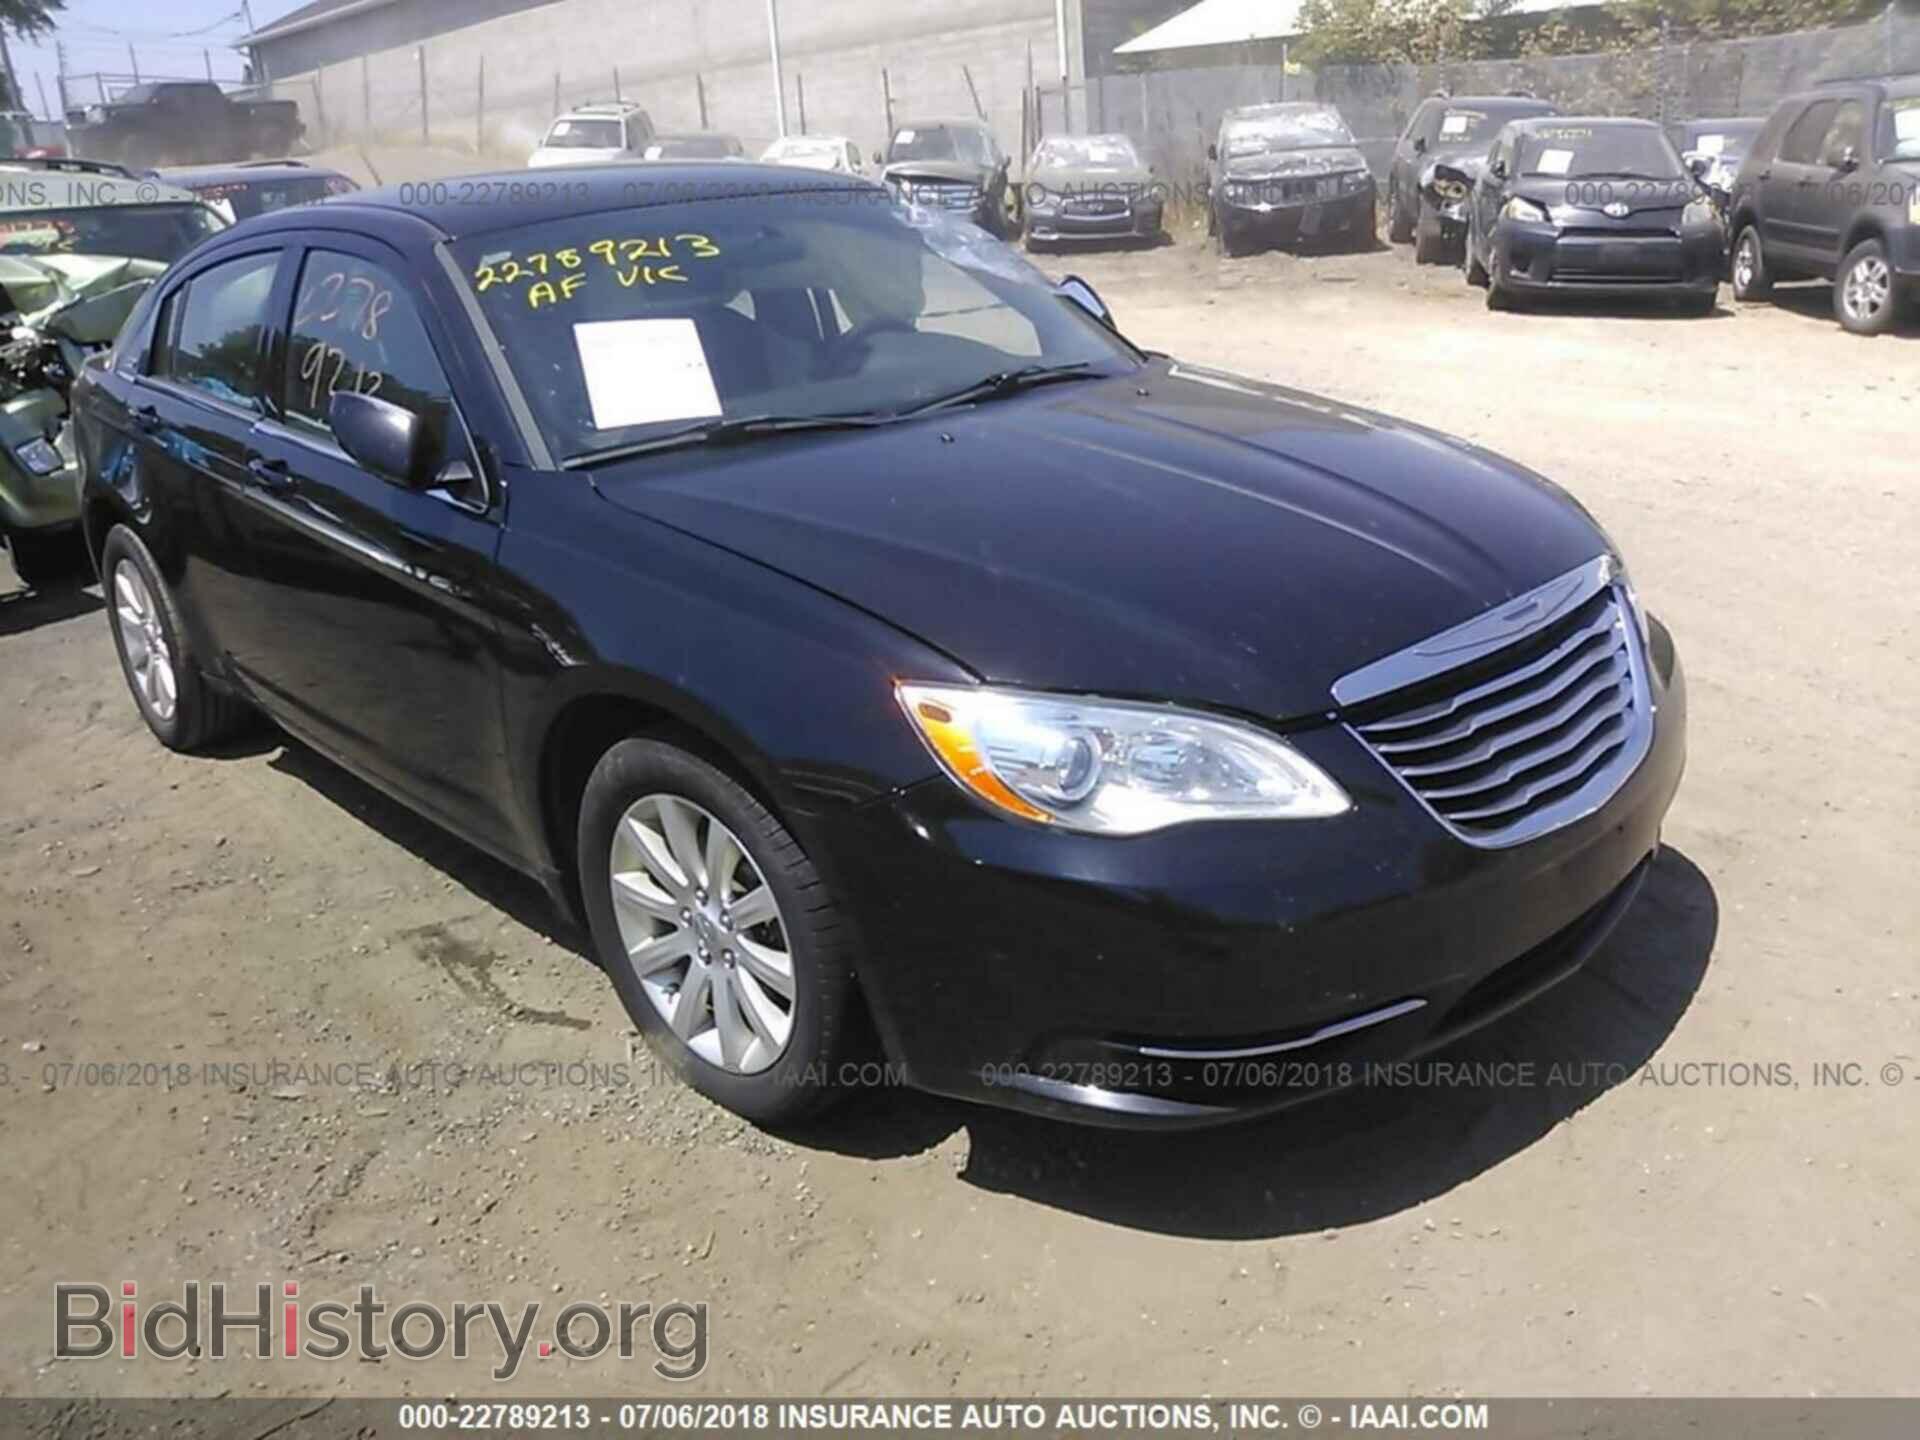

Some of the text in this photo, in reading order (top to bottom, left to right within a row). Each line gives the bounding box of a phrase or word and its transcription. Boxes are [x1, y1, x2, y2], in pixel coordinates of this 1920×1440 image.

[475, 234, 720, 291] 22789213
[528, 264, 689, 308] AF VIC
